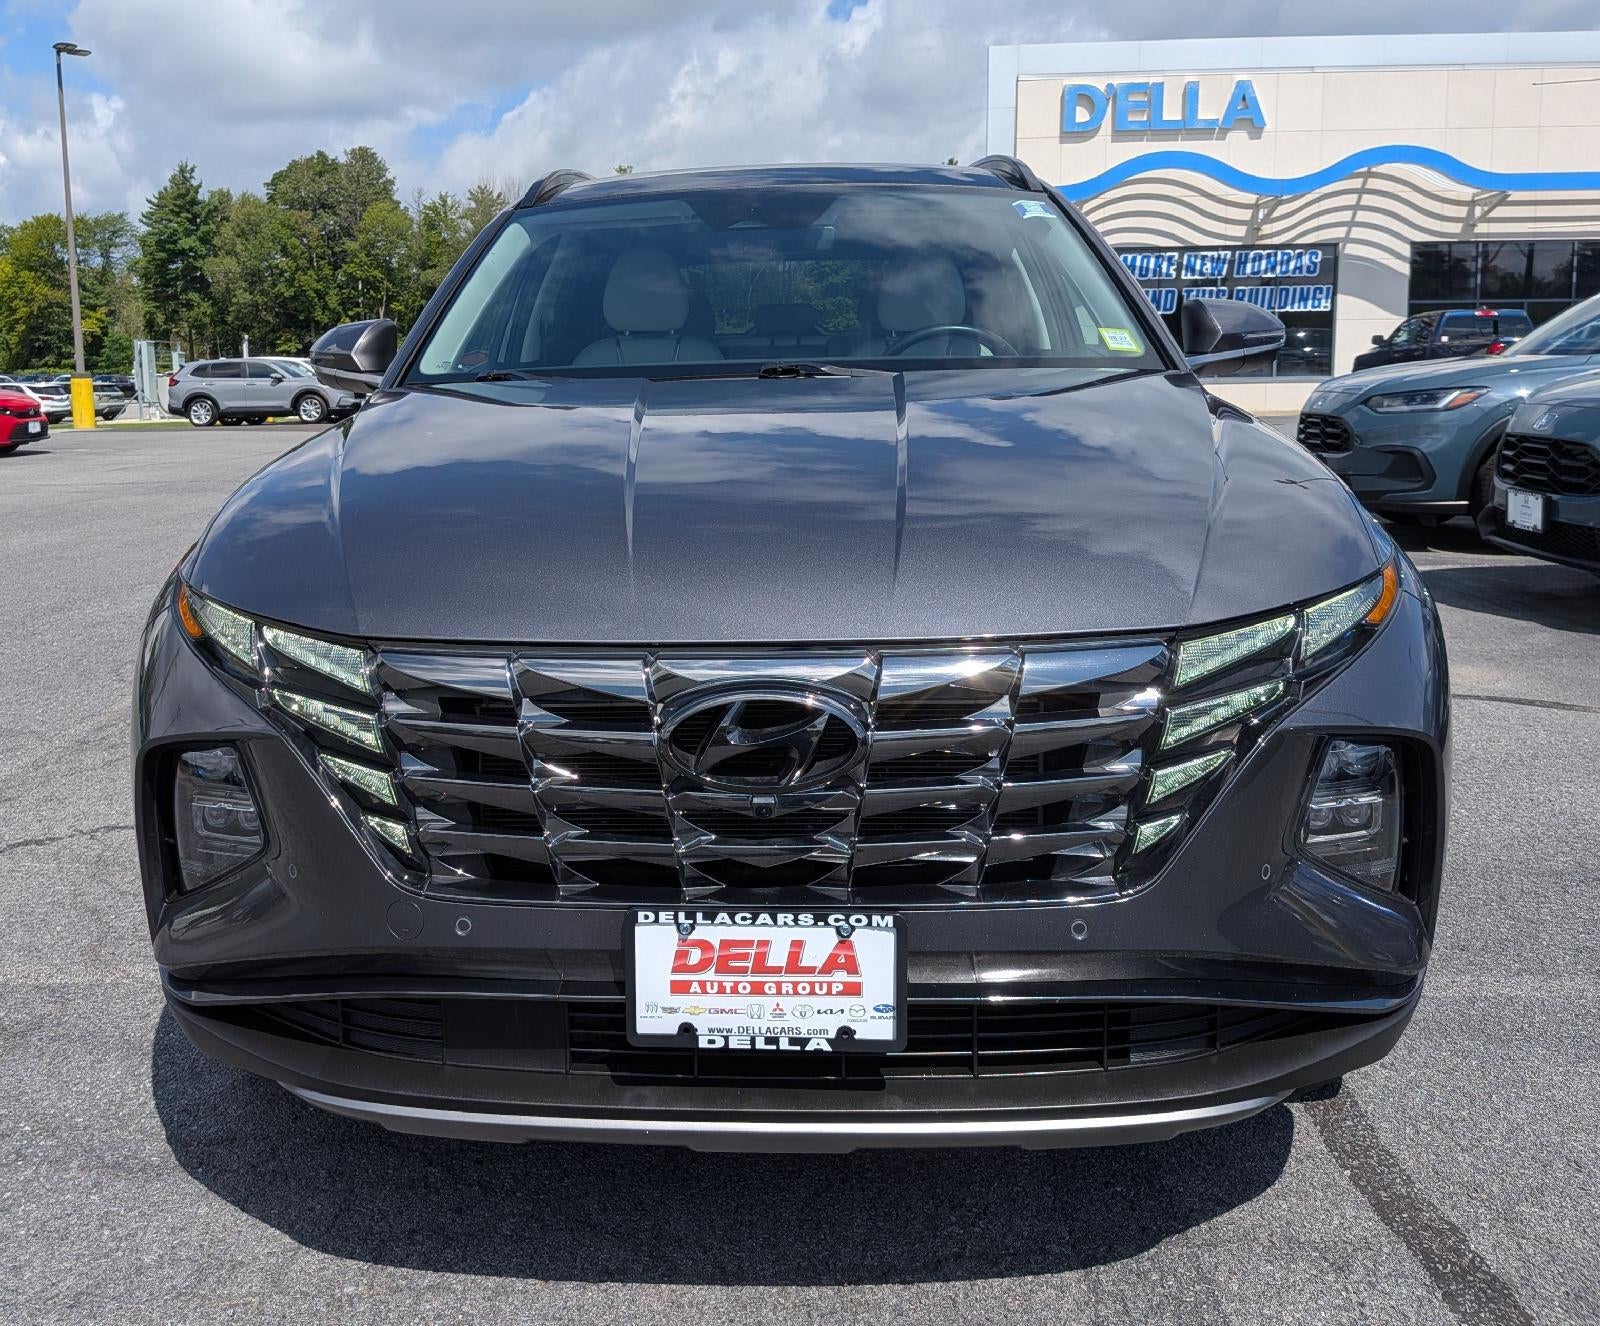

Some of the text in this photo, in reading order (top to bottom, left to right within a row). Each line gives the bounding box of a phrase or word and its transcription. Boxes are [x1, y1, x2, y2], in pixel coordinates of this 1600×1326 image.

[1063, 80, 1267, 132] D'ELLA
[1120, 249, 1322, 280] MORE NEW HONDAS
[637, 910, 894, 927] DELLACARS.COM
[670, 938, 863, 977] DELLA
[689, 982, 844, 995] AUTO GROUP
[707, 1025, 829, 1036] www.DELLACARS.com
[699, 1035, 832, 1051] DELLA
